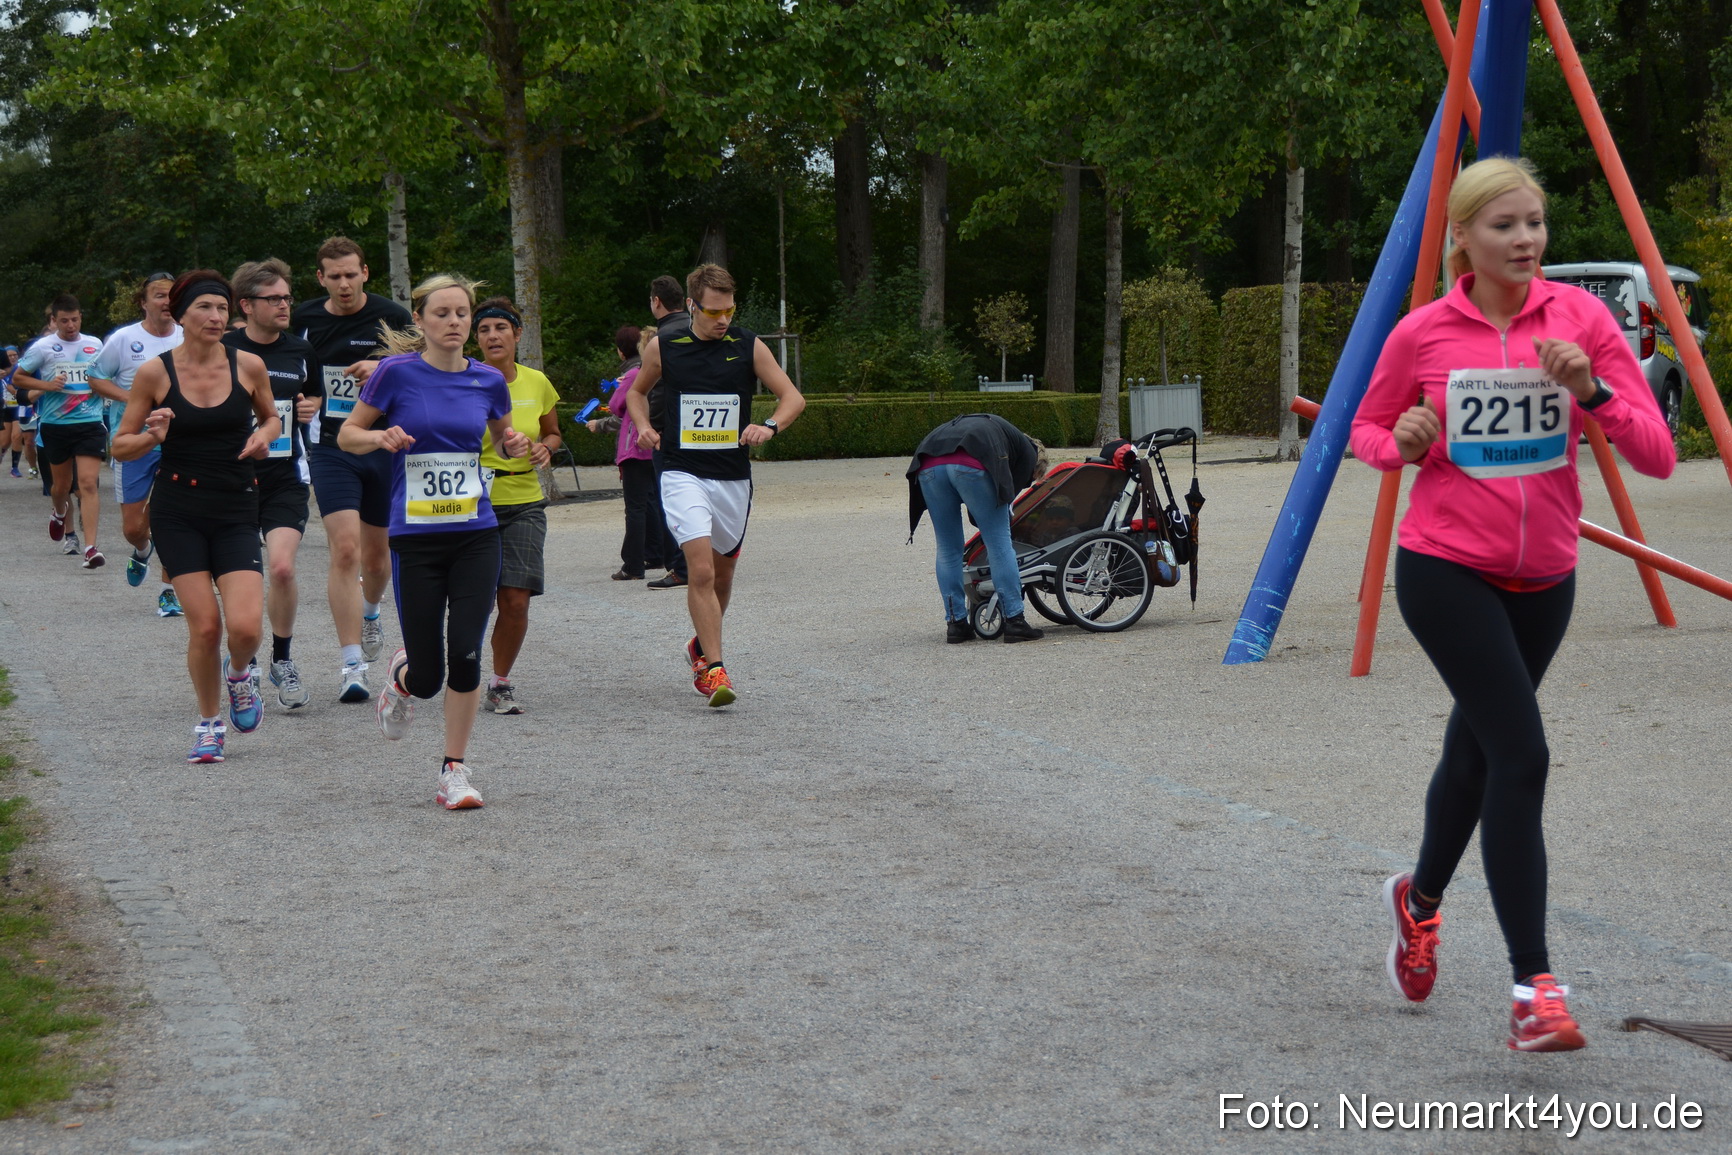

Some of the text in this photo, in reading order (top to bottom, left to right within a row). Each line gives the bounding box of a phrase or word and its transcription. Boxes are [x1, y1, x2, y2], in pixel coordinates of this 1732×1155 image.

[271, 371, 300, 380] PFLEIDERER
[330, 379, 360, 398] 22
[1450, 379, 1551, 390] PARTL Neumarkt
[340, 402, 354, 410] And
[693, 408, 729, 428] 277
[1460, 393, 1560, 435] 2215
[692, 433, 729, 442] Sebastian
[1482, 445, 1539, 462] Natalie
[407, 460, 432, 468] PARTL
[423, 470, 468, 497] 362
[432, 503, 462, 514] Nadja
